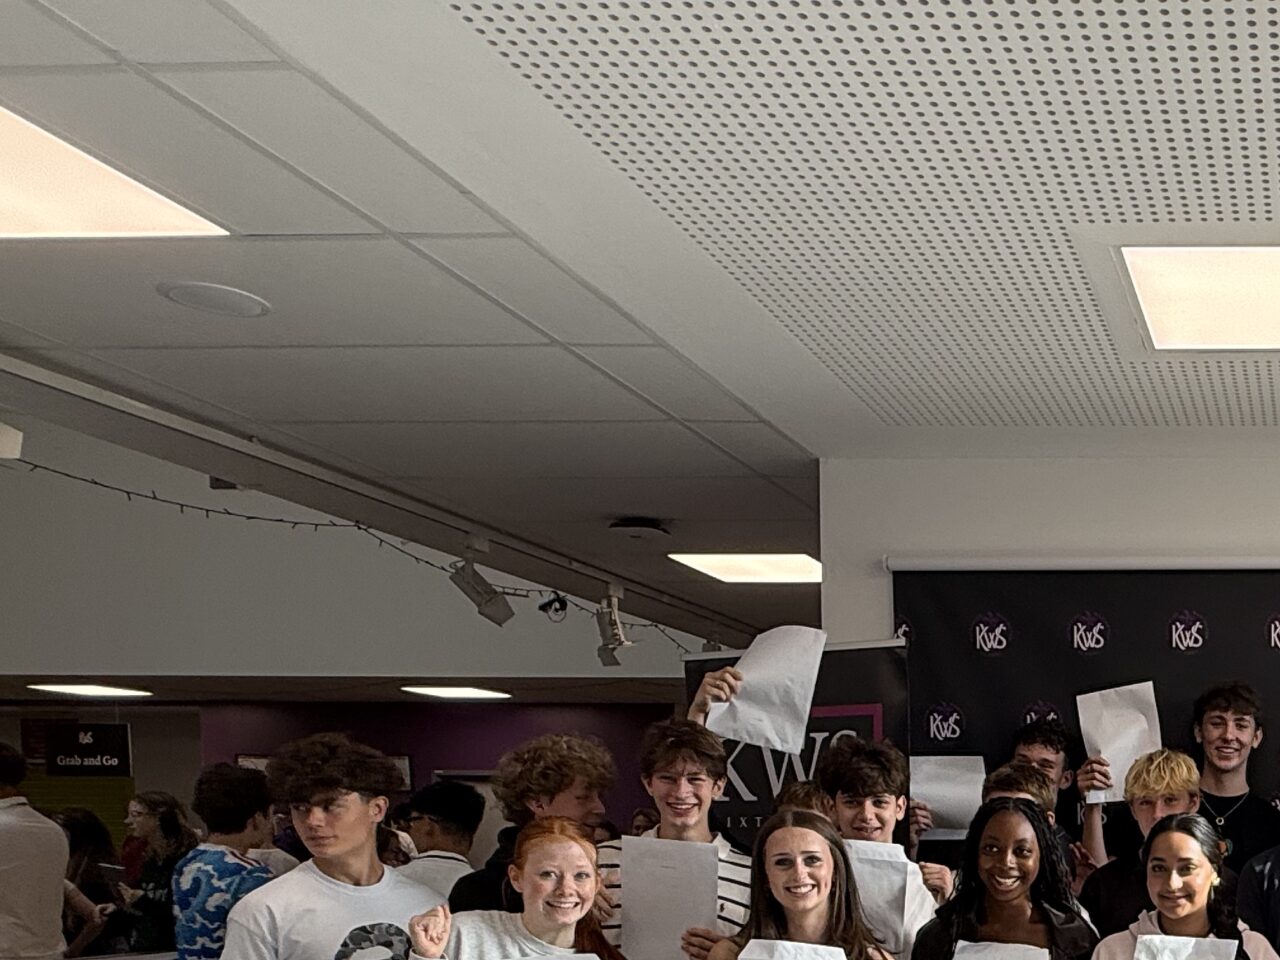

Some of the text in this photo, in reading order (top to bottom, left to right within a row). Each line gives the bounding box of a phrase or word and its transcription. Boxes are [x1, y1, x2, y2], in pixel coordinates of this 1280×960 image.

[977, 624, 1006, 651] KWS
[1074, 623, 1104, 650] KWS
[1173, 622, 1202, 650] KWS
[931, 713, 959, 740] KWS
[57, 754, 119, 766] Grab and Go
[726, 816, 763, 829] IXT
[1077, 801, 1108, 825] KS
